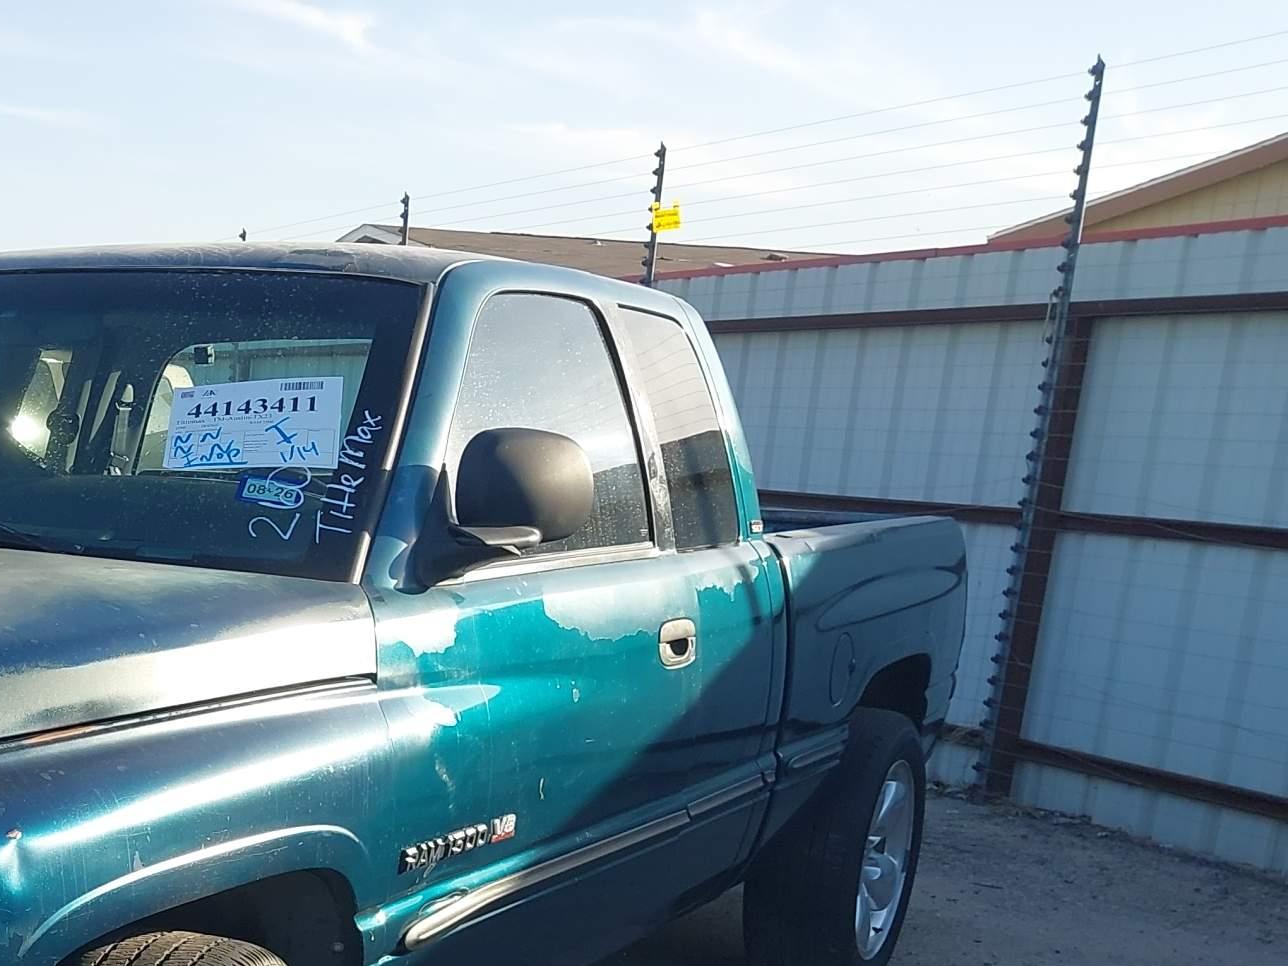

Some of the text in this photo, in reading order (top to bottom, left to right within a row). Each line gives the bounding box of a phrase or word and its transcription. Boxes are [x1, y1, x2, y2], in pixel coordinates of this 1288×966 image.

[187, 395, 318, 418] 44143411
[399, 813, 517, 874] RAM 1500 V8
